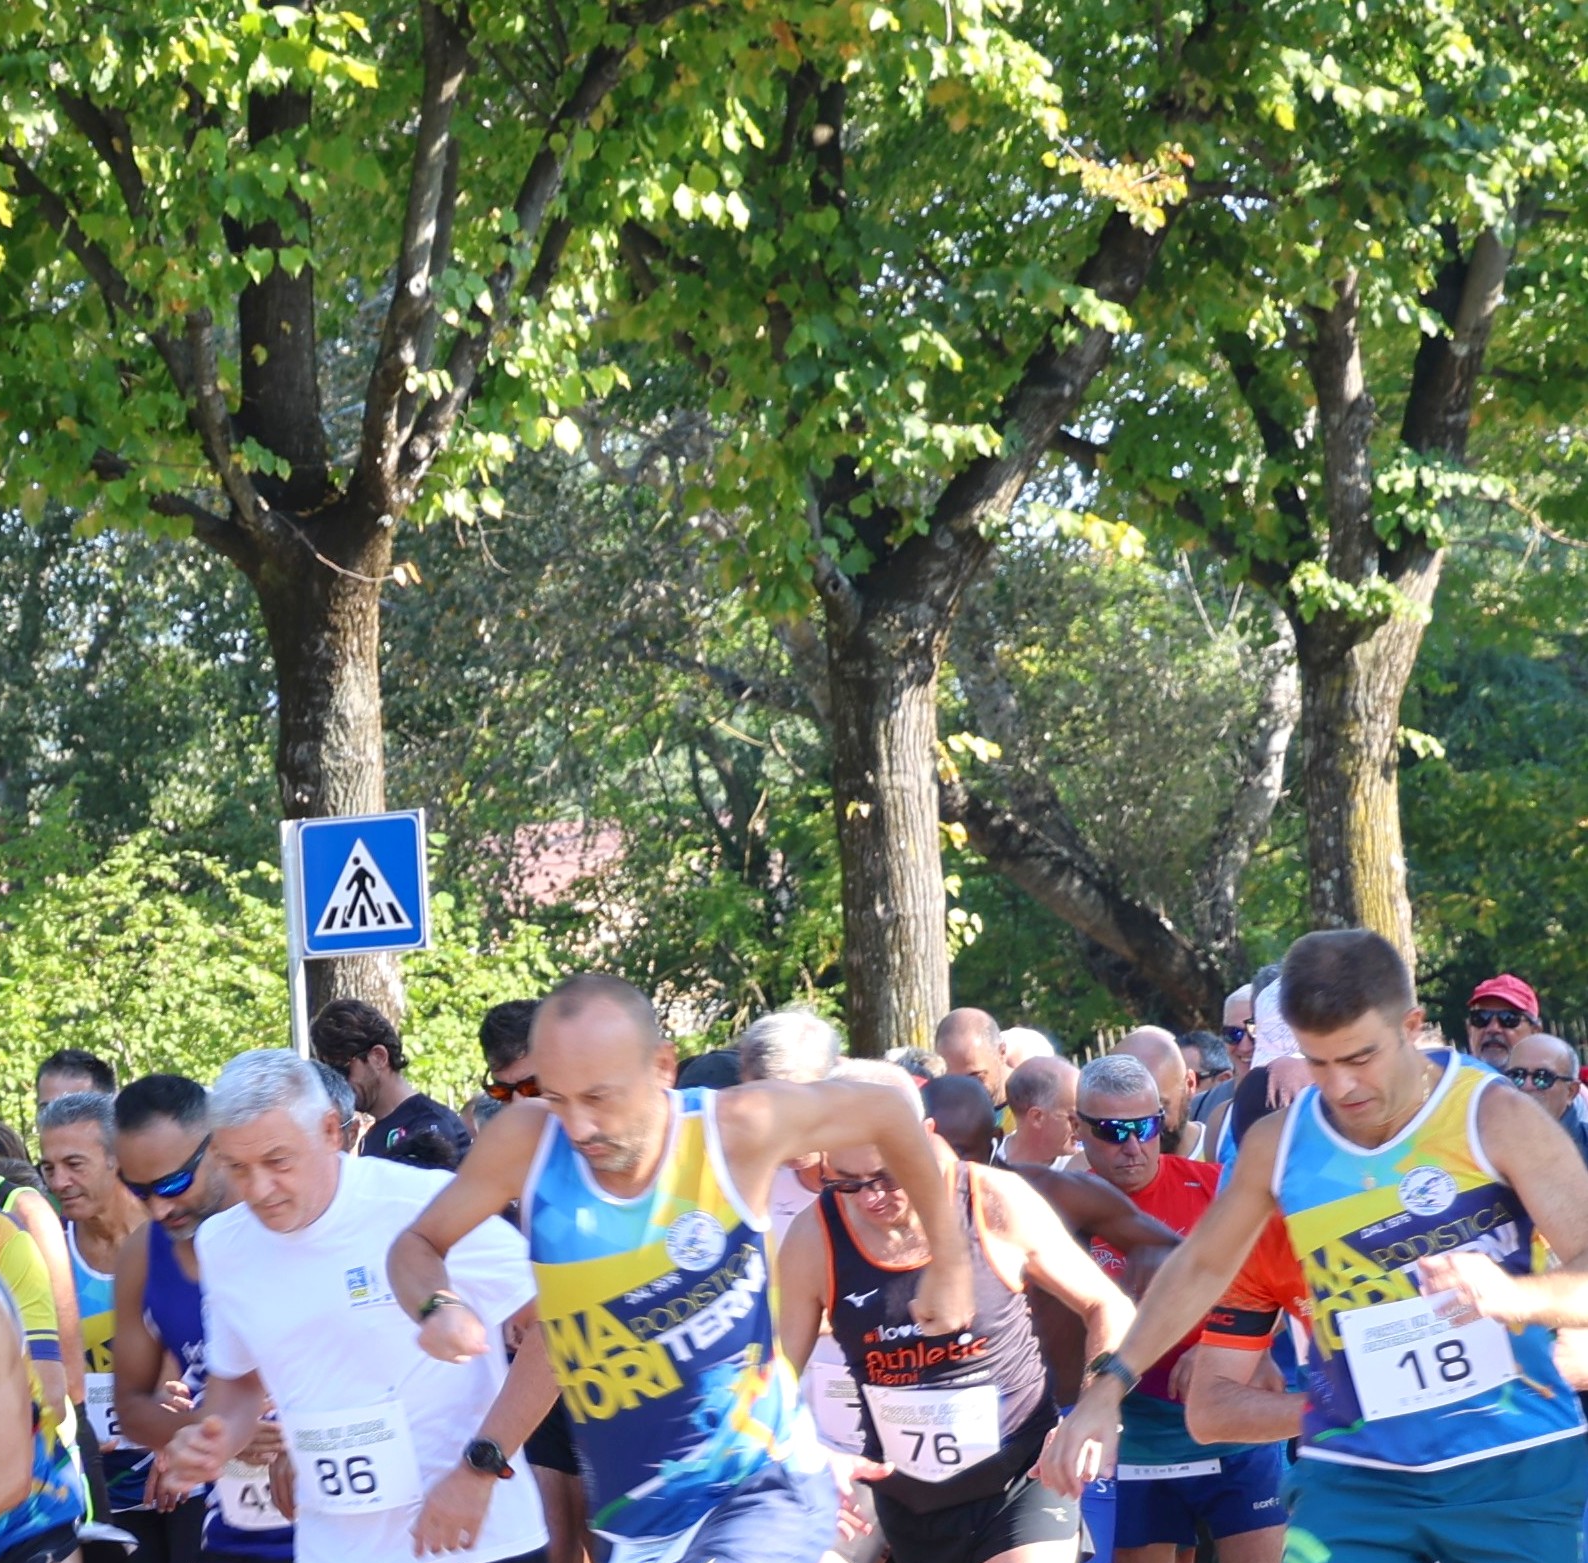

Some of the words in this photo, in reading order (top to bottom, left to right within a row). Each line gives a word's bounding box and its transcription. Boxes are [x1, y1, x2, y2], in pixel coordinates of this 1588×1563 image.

[1330, 1201, 1514, 1269] PODISTICA
[865, 1336, 988, 1382] Athletic
[1396, 1339, 1472, 1391] 18
[901, 1429, 962, 1466] 76
[315, 1455, 379, 1496] 86
